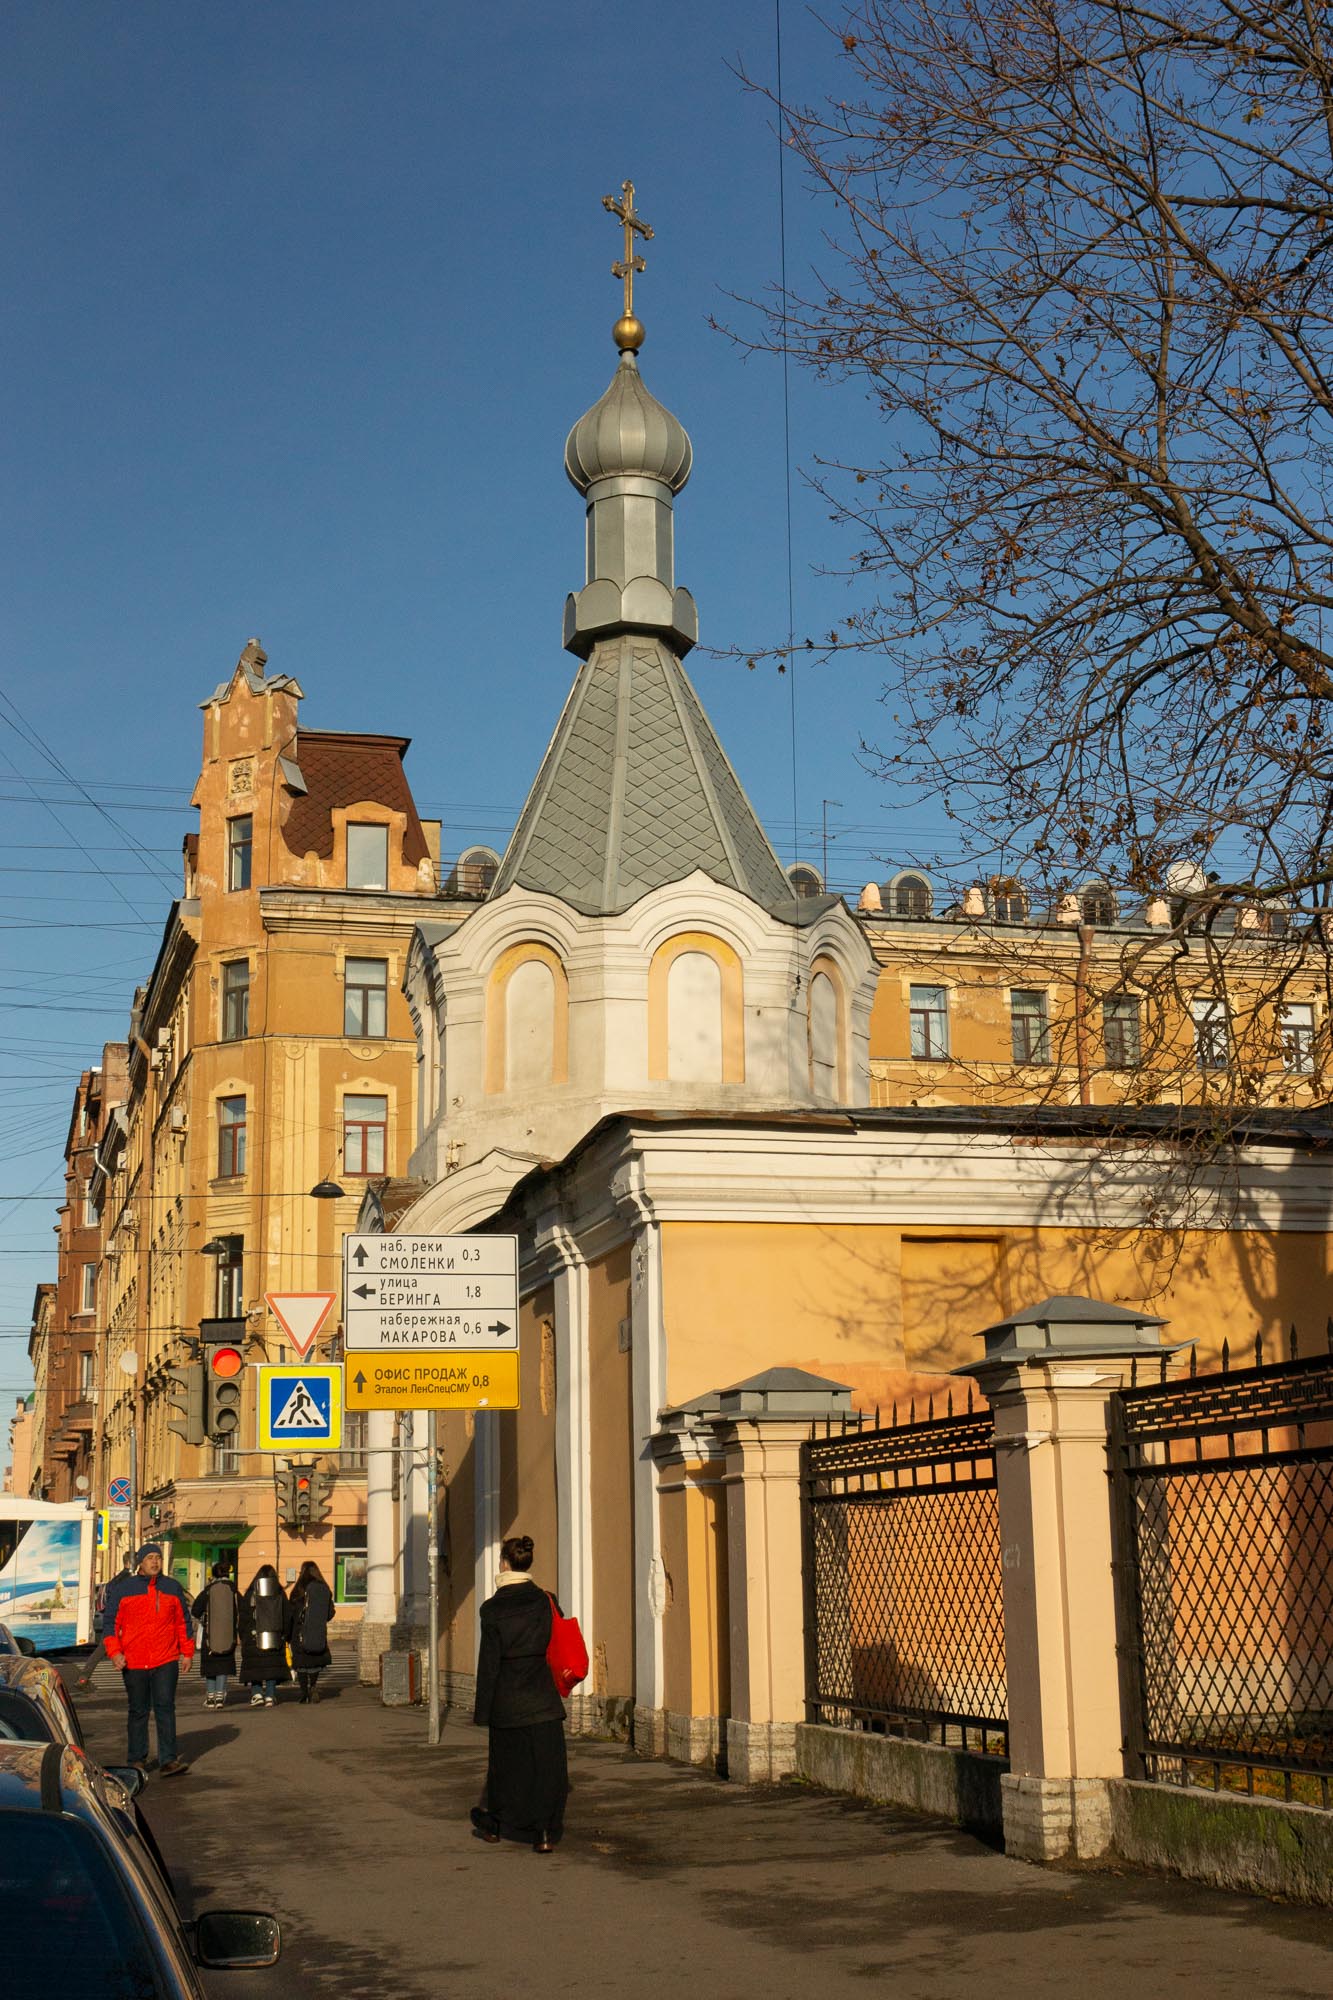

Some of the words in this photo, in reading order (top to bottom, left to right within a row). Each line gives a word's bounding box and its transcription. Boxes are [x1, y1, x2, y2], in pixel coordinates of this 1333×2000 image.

[380, 1240, 406, 1252] наб.
[412, 1242, 443, 1254] реки
[380, 1257, 455, 1269] СМОЛЕНКИ
[380, 1277, 418, 1290] улица
[380, 1293, 440, 1305] БЕРИНГА
[380, 1313, 461, 1327] набережная
[380, 1331, 456, 1342] МАКАРОВА
[374, 1369, 411, 1380] ОФИС
[414, 1368, 467, 1381] ПРОДАЖ
[472, 1375, 489, 1388] 0,8
[374, 1384, 408, 1394] Эталон
[410, 1383, 470, 1394] ЛенСпецСМУ
